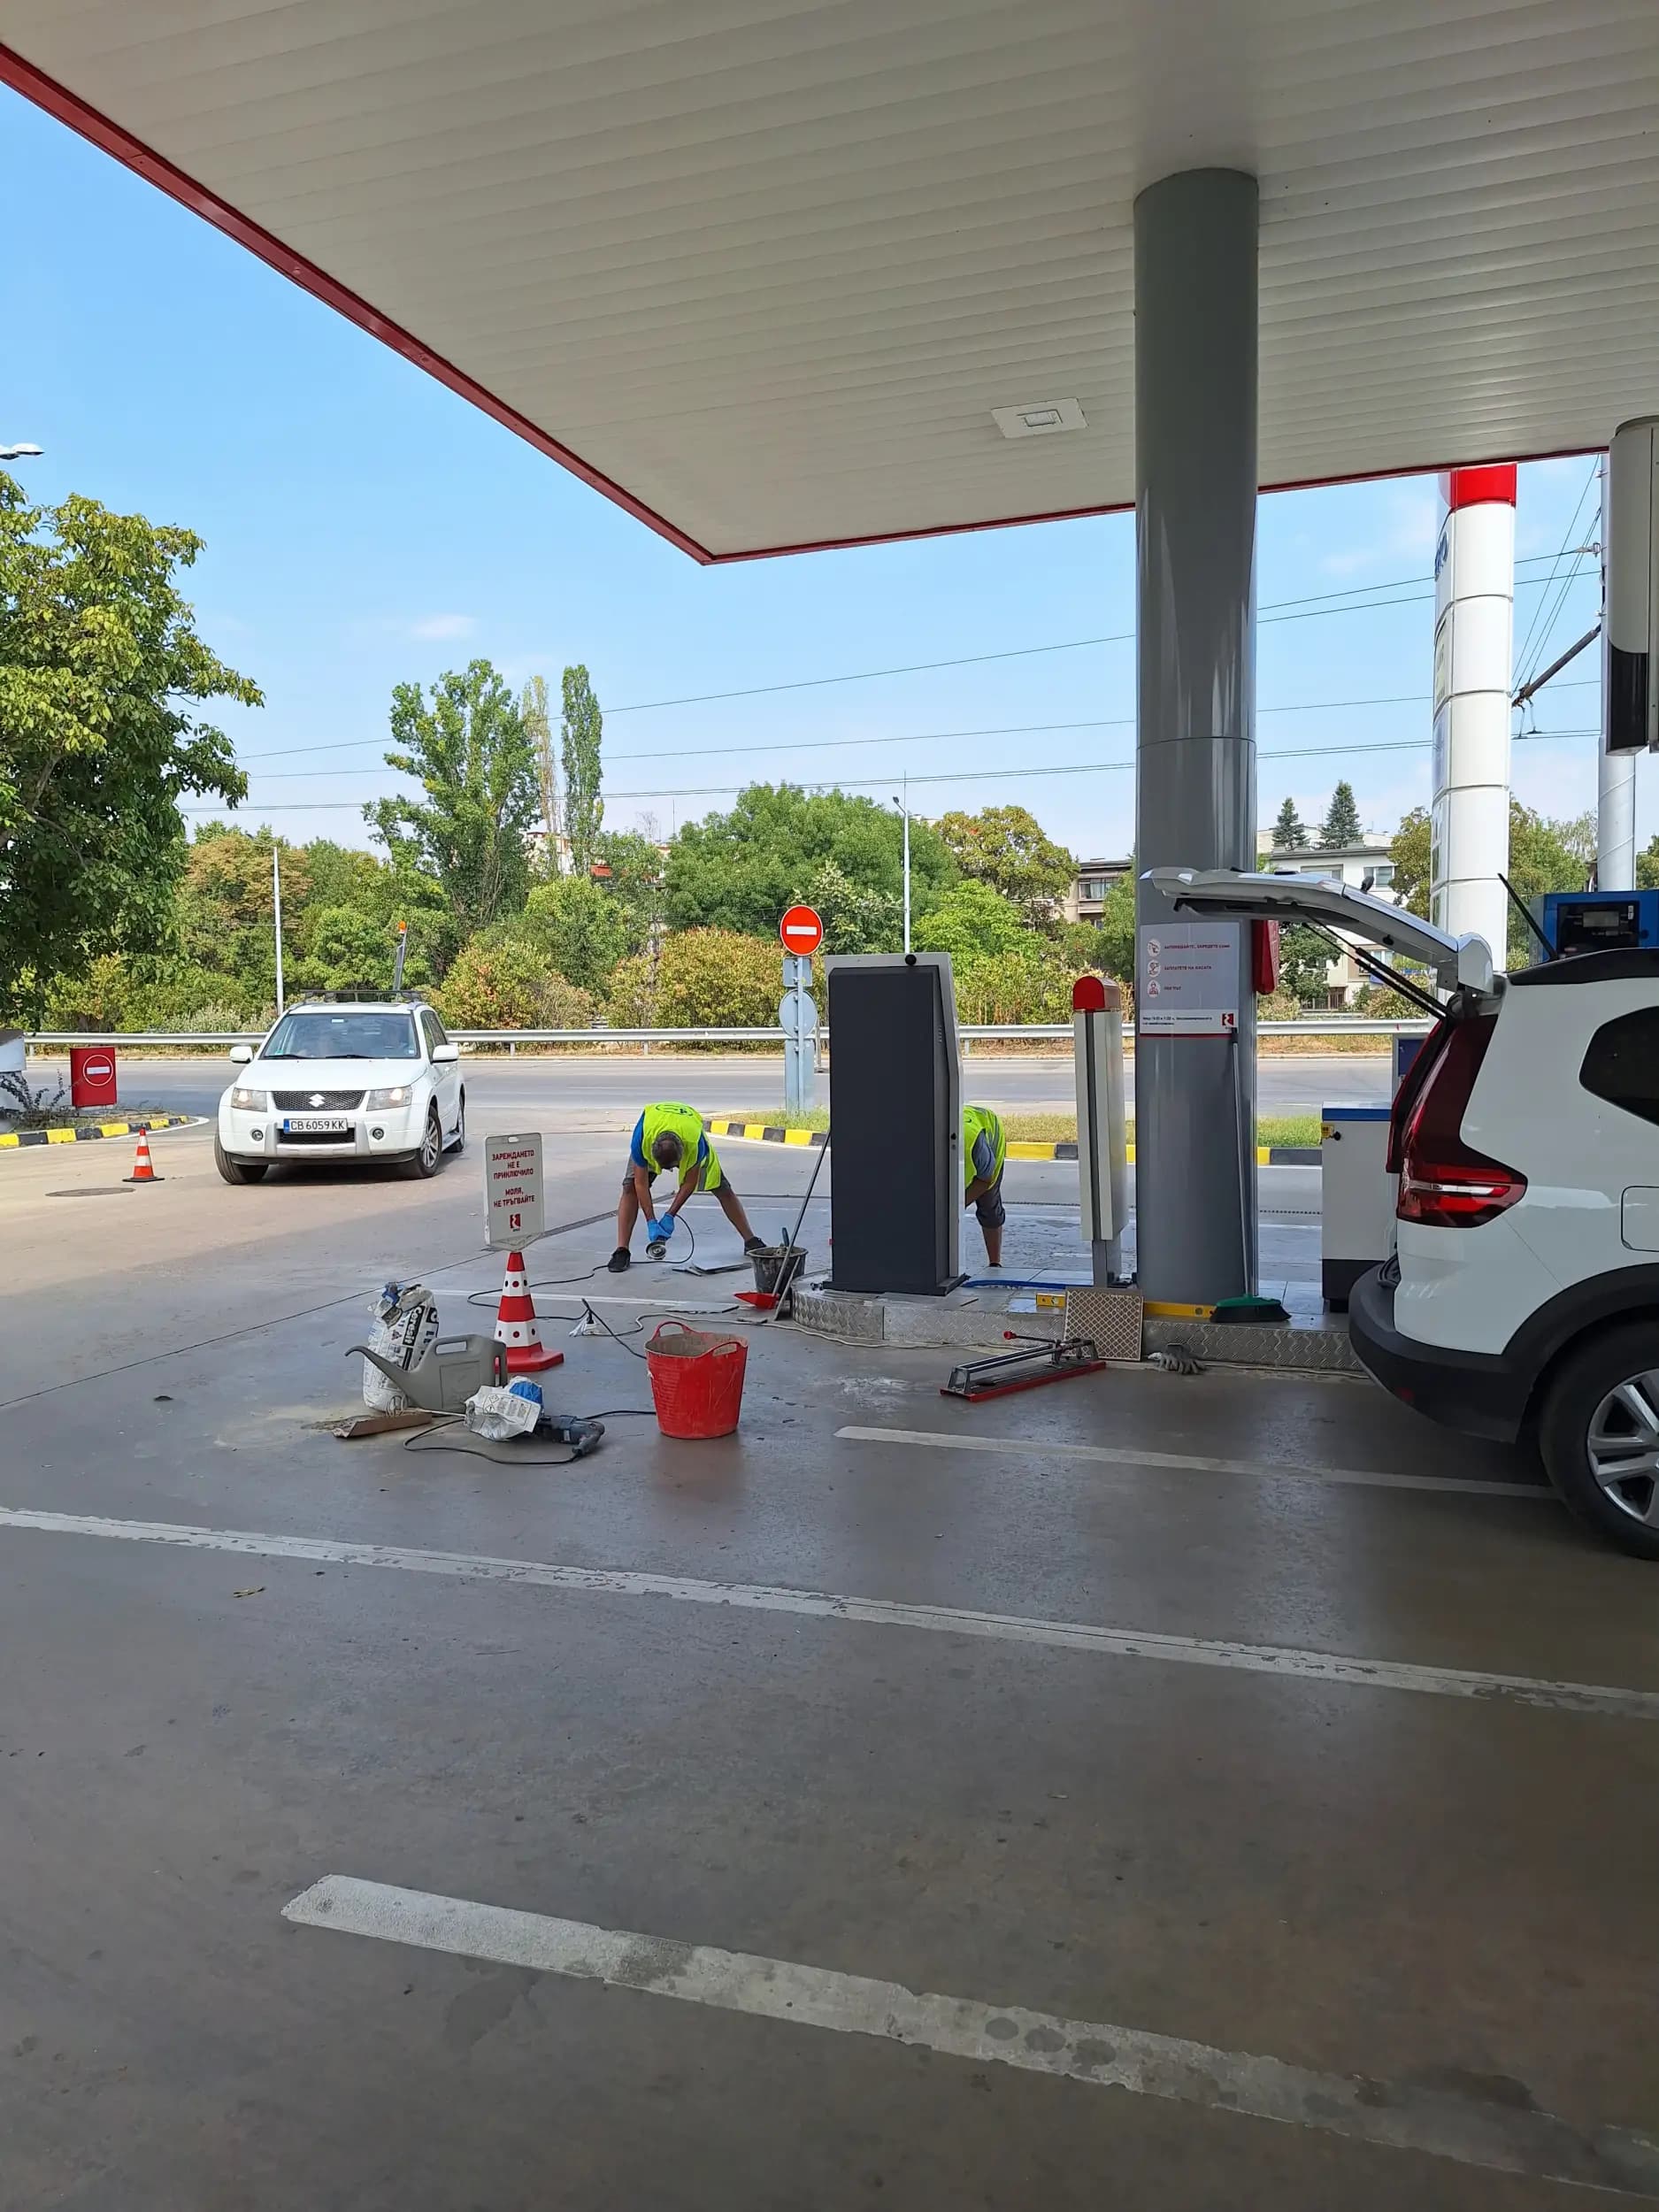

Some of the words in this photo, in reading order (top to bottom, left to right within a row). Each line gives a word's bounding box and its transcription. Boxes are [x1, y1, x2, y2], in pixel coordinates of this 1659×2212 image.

[306, 1120, 329, 1130] 6059
[492, 1149, 534, 1161] ЗАРЕЖДАНЕТО
[494, 1168, 534, 1179] ПРИКЛЮЧИЛО
[505, 1187, 524, 1195] МОЛЯ,
[503, 1195, 534, 1207] ТРЪГВАЙТЕ
[404, 1306, 423, 1344] Ceresit
